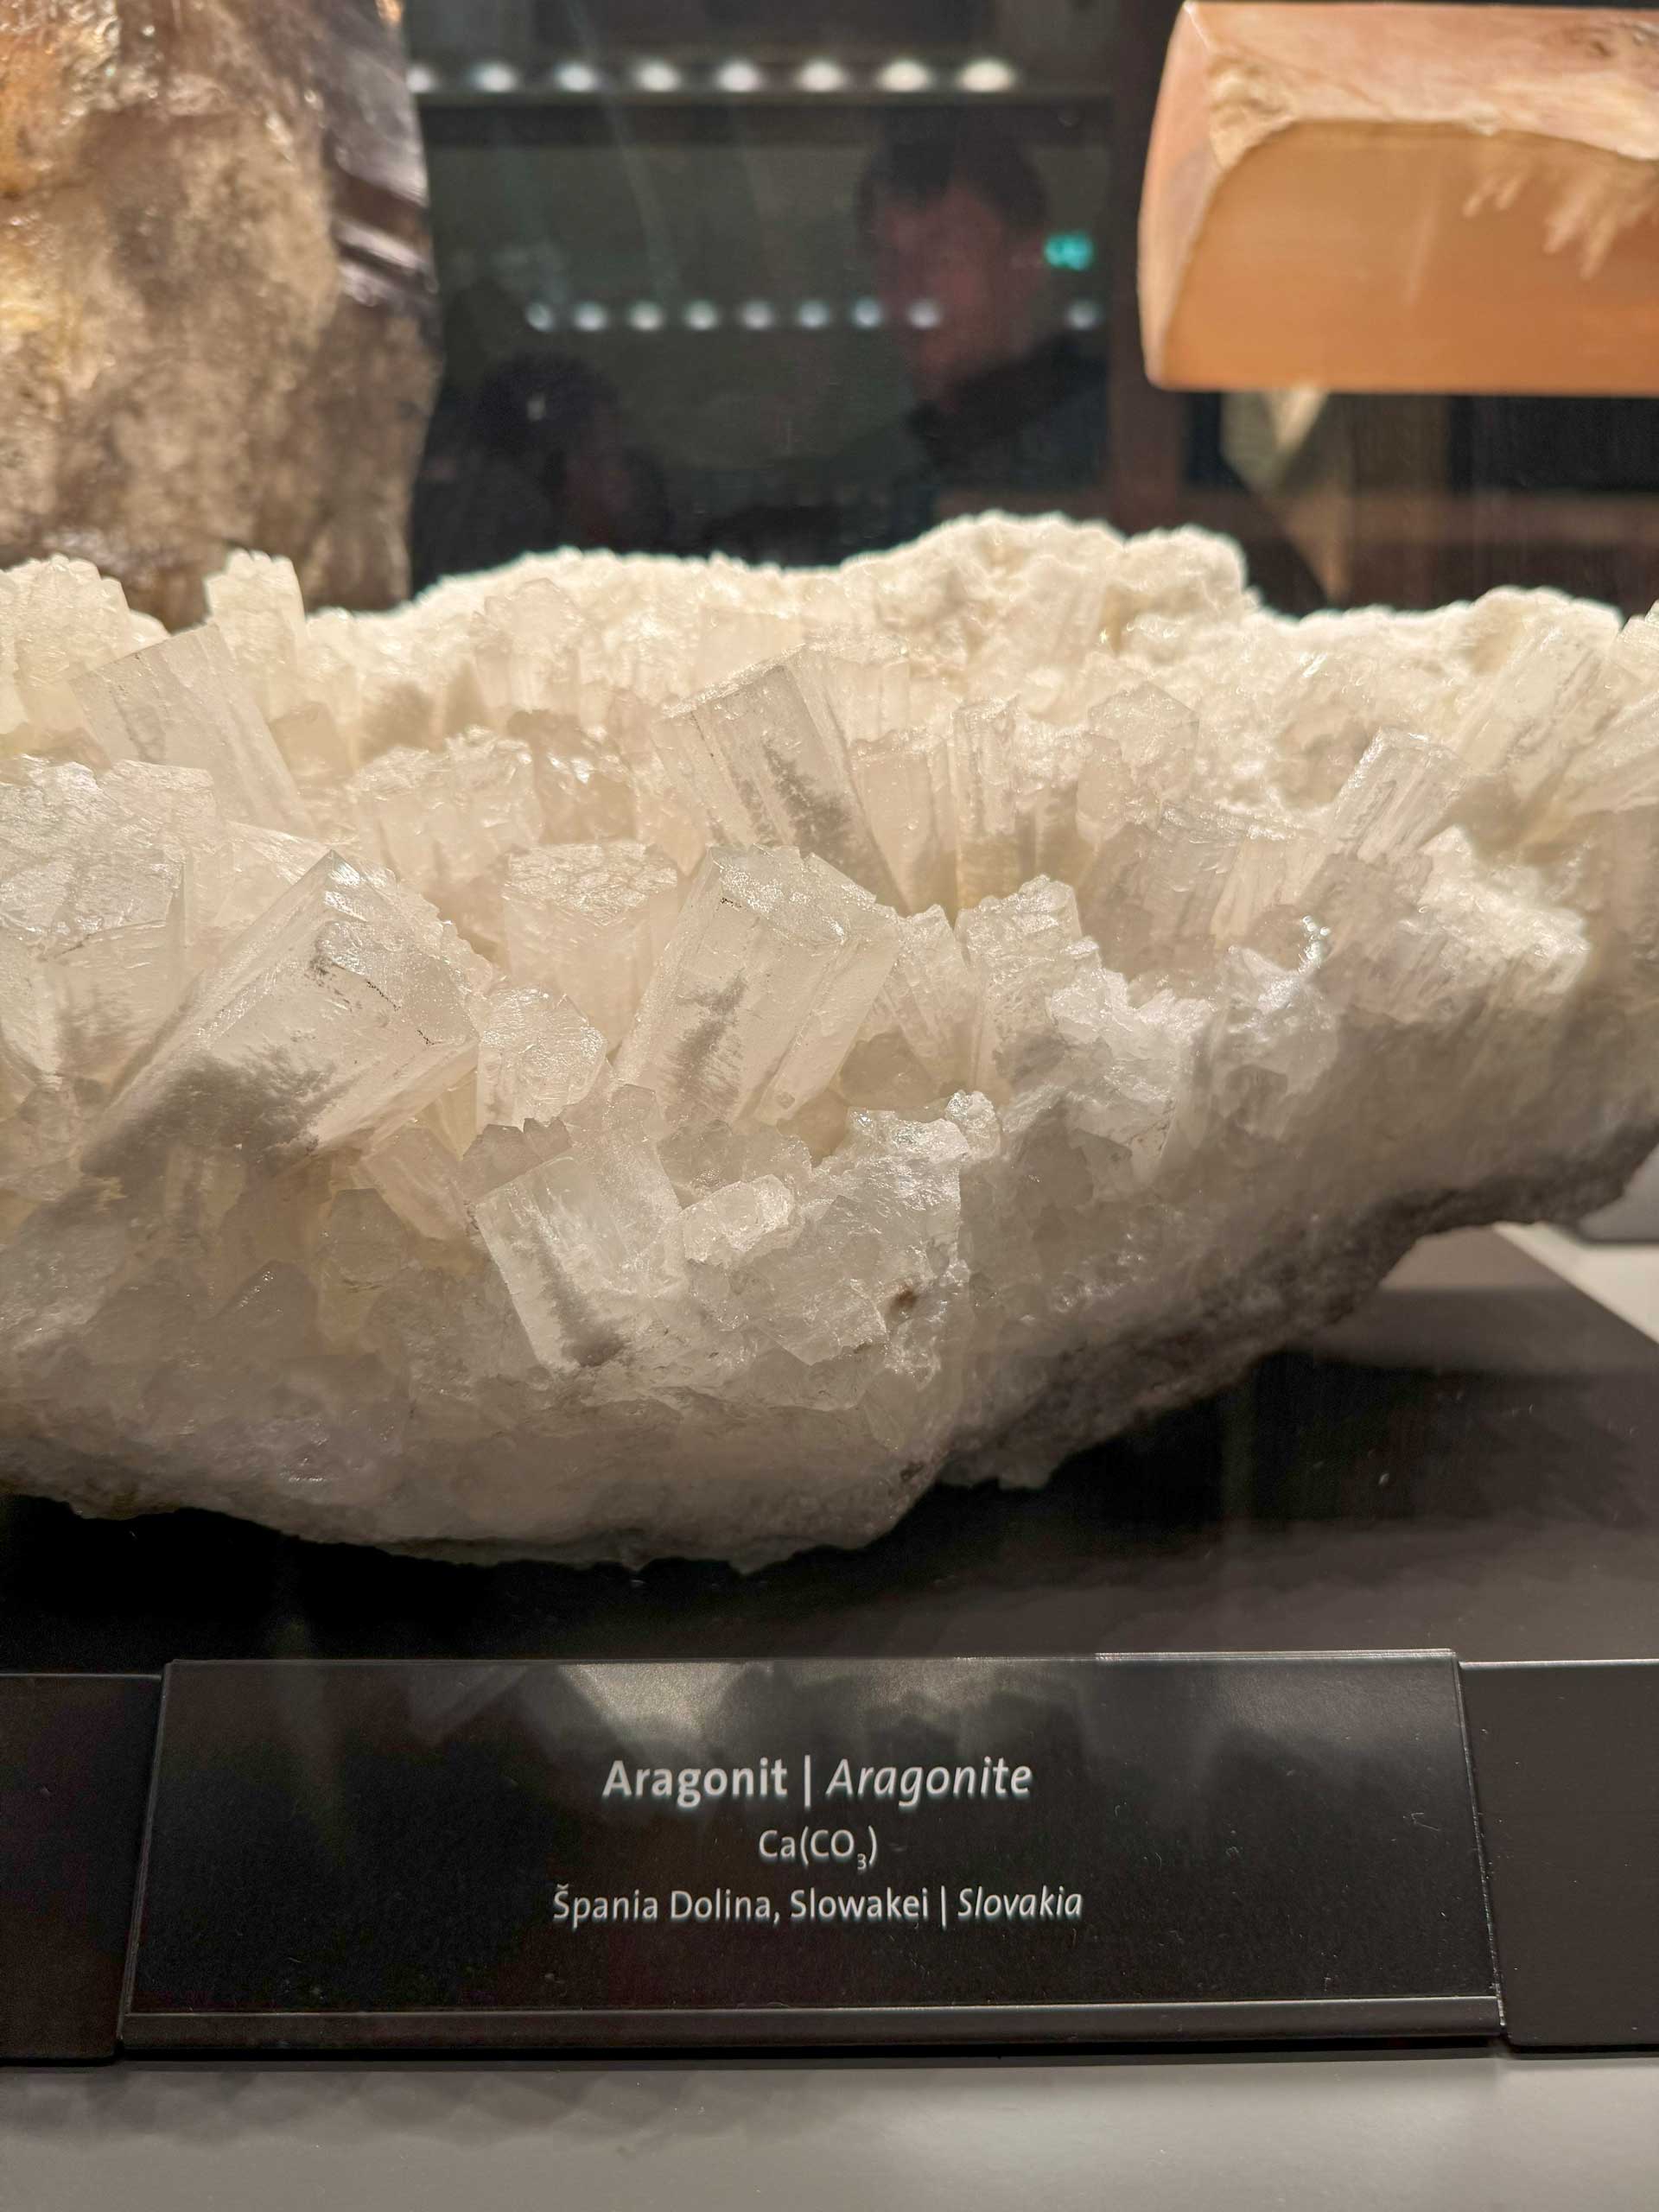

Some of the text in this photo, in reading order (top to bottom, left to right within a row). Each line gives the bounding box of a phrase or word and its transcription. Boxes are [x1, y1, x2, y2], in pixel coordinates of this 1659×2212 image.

[602, 1757, 788, 1809] Aragonit
[825, 1756, 1033, 1808] Aragonite
[553, 1883, 658, 1929] Špania
[671, 1888, 780, 1925] Dolina,
[791, 1886, 928, 1919] Slowakei
[957, 1885, 1082, 1918] Slovakia
